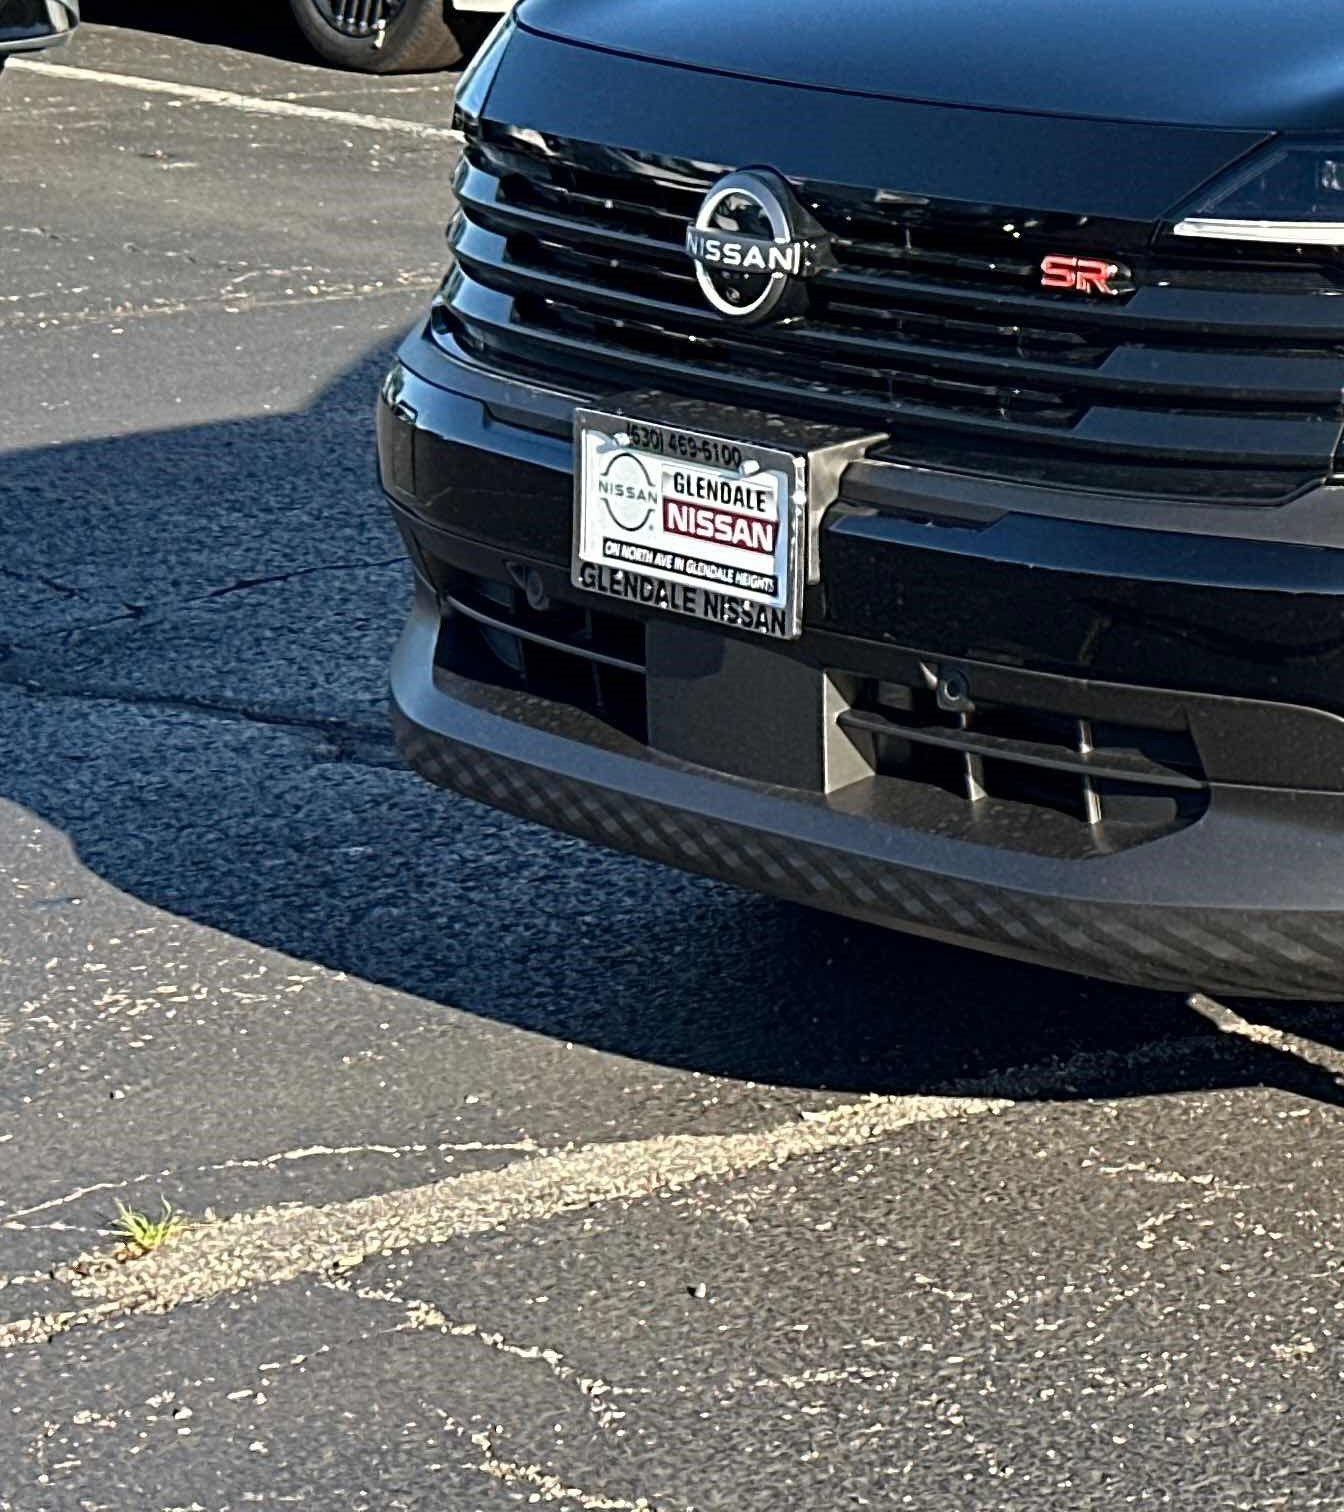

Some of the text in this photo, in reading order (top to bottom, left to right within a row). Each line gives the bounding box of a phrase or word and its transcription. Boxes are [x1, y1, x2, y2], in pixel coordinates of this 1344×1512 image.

[686, 231, 794, 271] NISSAN
[1040, 256, 1119, 295] SR
[598, 478, 658, 505] NISSAN
[673, 471, 766, 513] GLENDALE
[667, 502, 774, 552] NISSAN
[605, 540, 620, 555] ON
[621, 543, 653, 564] NORTH
[654, 553, 673, 570] AVE
[674, 558, 685, 573] IN
[685, 559, 734, 585] GLENDALE
[580, 562, 786, 636] GLENDALE NISSAN
